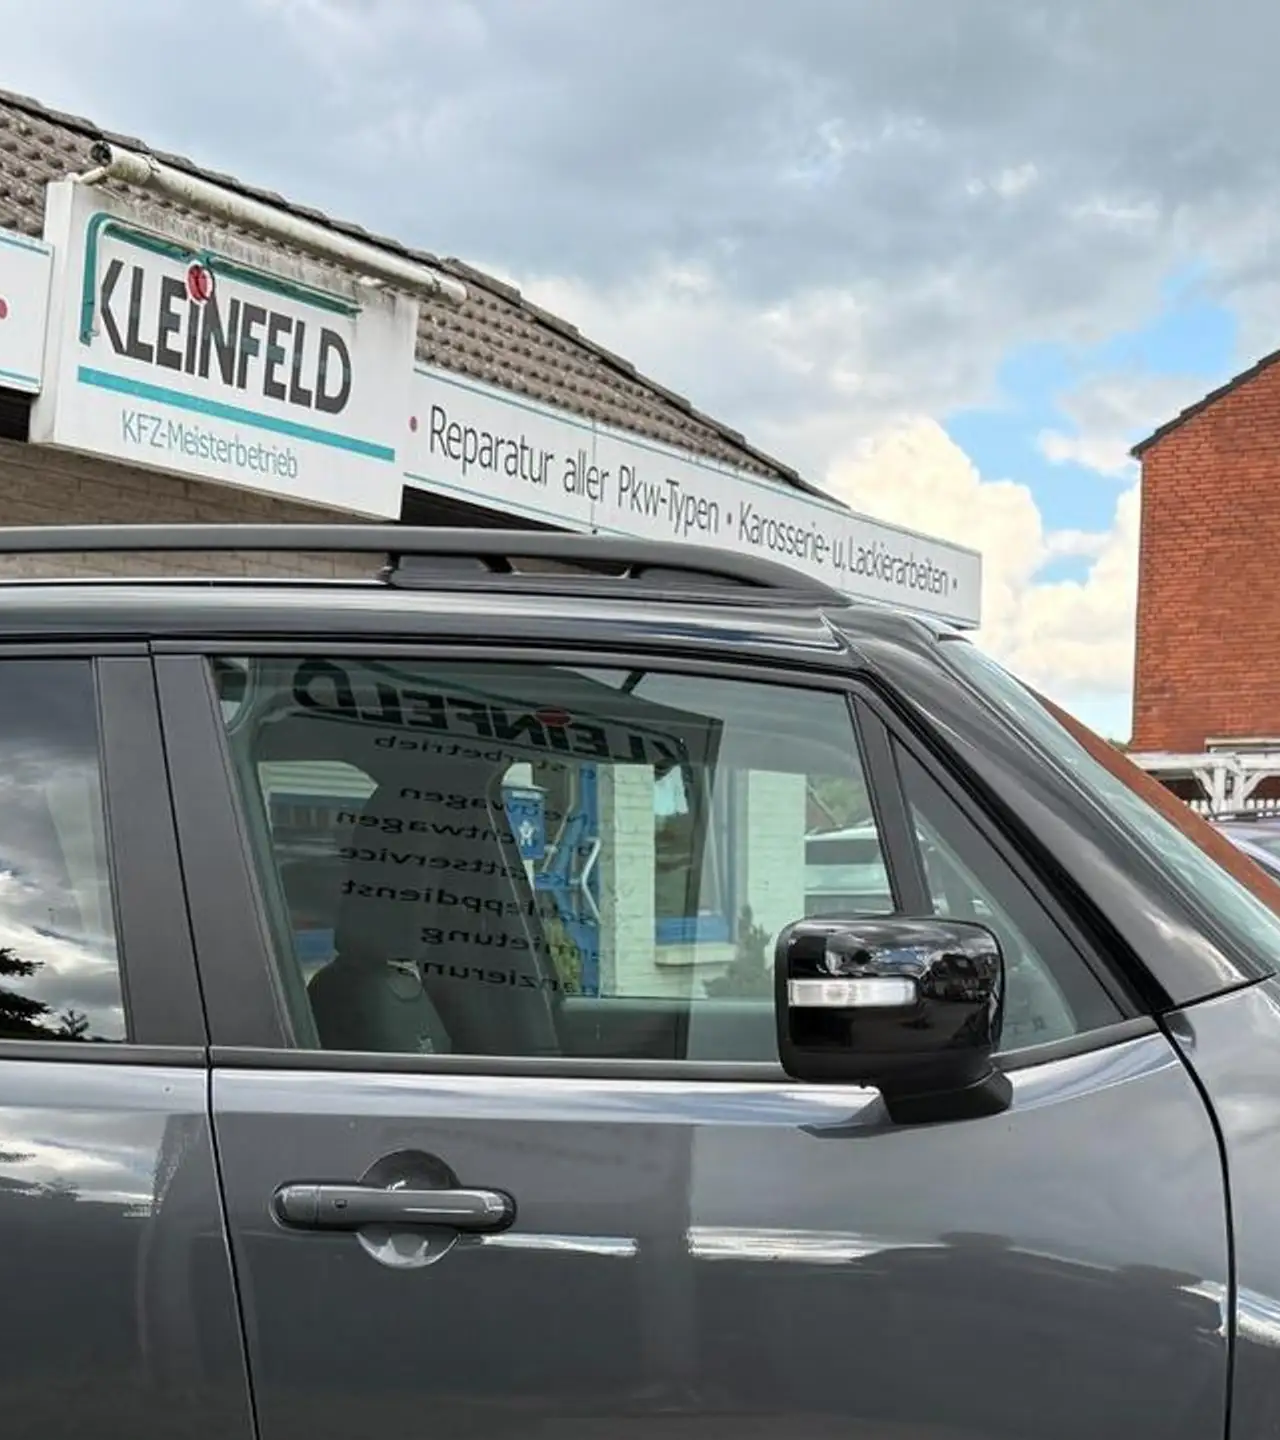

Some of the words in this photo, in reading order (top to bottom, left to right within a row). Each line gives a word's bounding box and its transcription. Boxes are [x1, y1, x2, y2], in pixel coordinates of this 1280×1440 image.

[100, 258, 352, 415] KLEINFELD
[121, 408, 299, 479] KFZ-Meisterbetrieb
[429, 404, 554, 488] Reparatur
[563, 448, 610, 503] aller
[618, 465, 720, 538] Pkw-Typen
[848, 536, 950, 597] Lackierarbeiten
